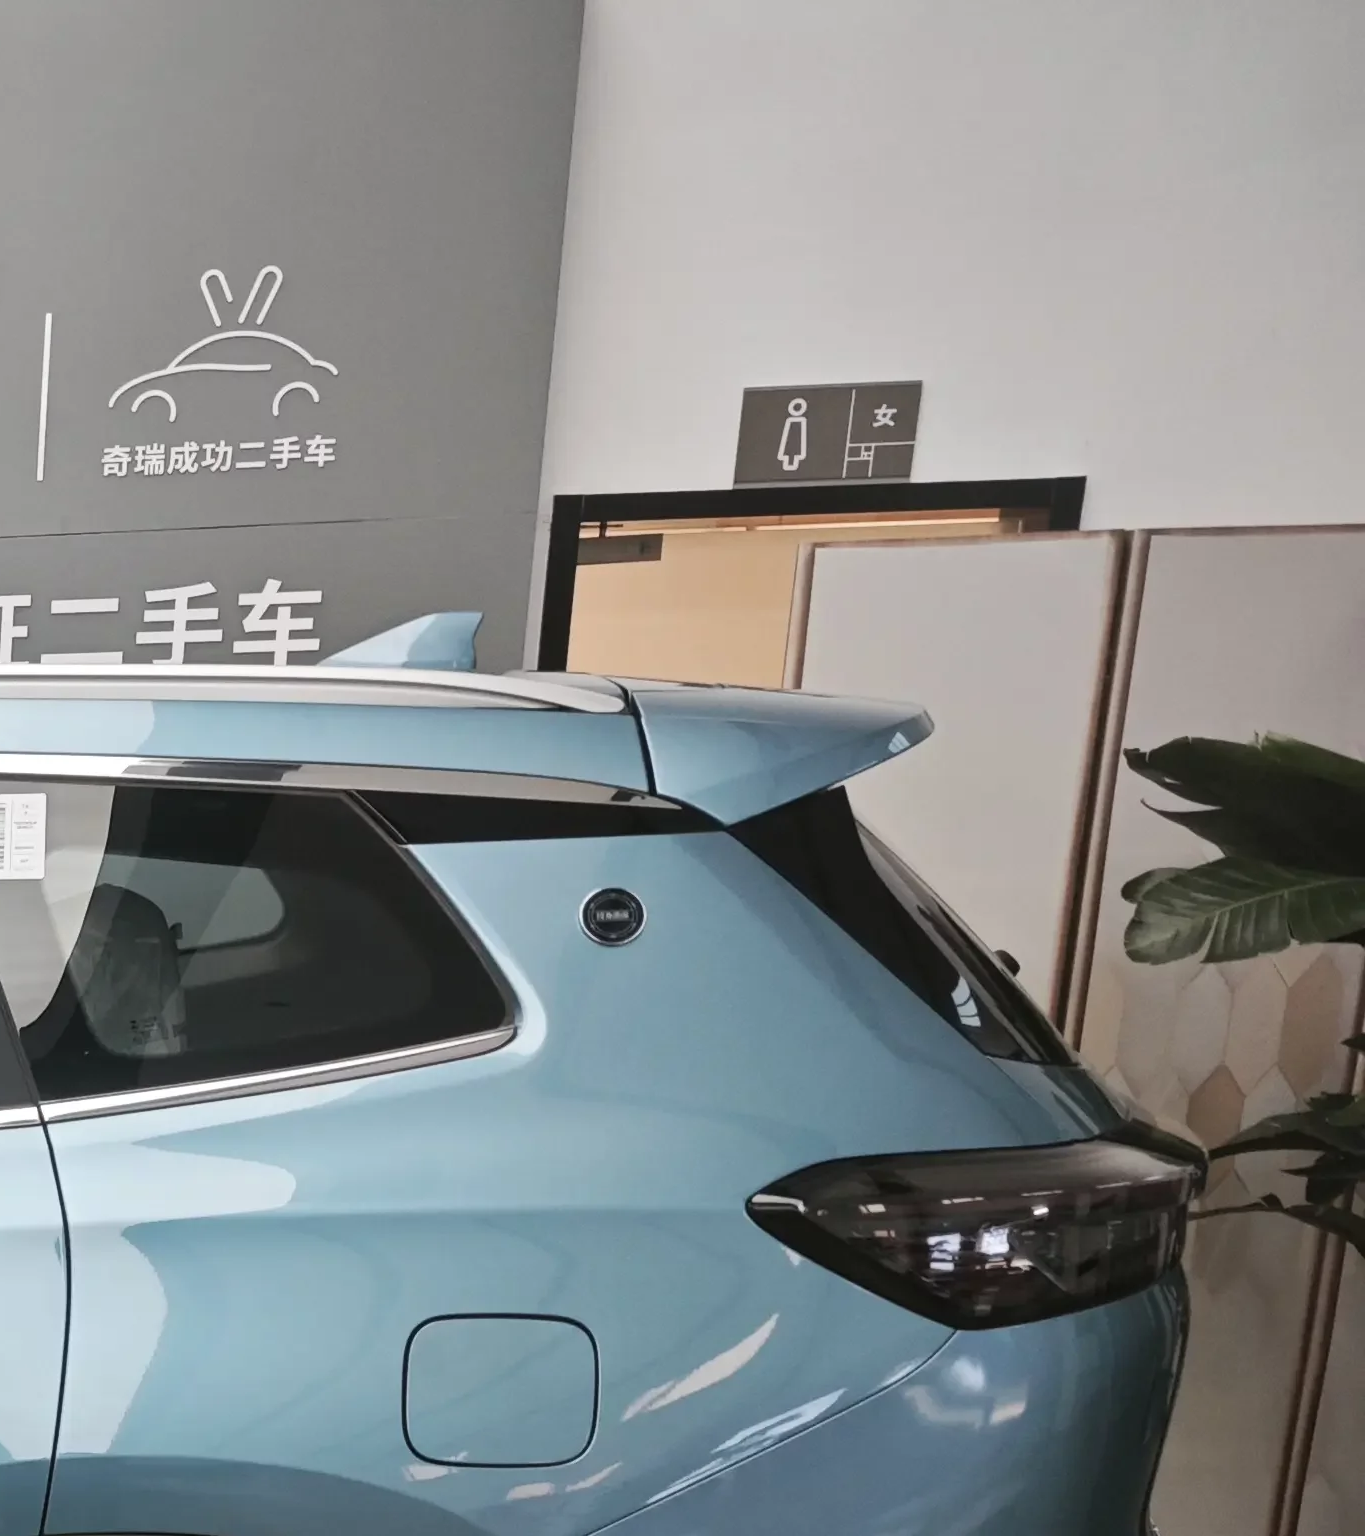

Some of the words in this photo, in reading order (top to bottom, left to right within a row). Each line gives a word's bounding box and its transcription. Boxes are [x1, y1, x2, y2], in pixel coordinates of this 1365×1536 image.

[872, 403, 898, 428] 女
[100, 434, 338, 478] 奇瑞成功二手车
